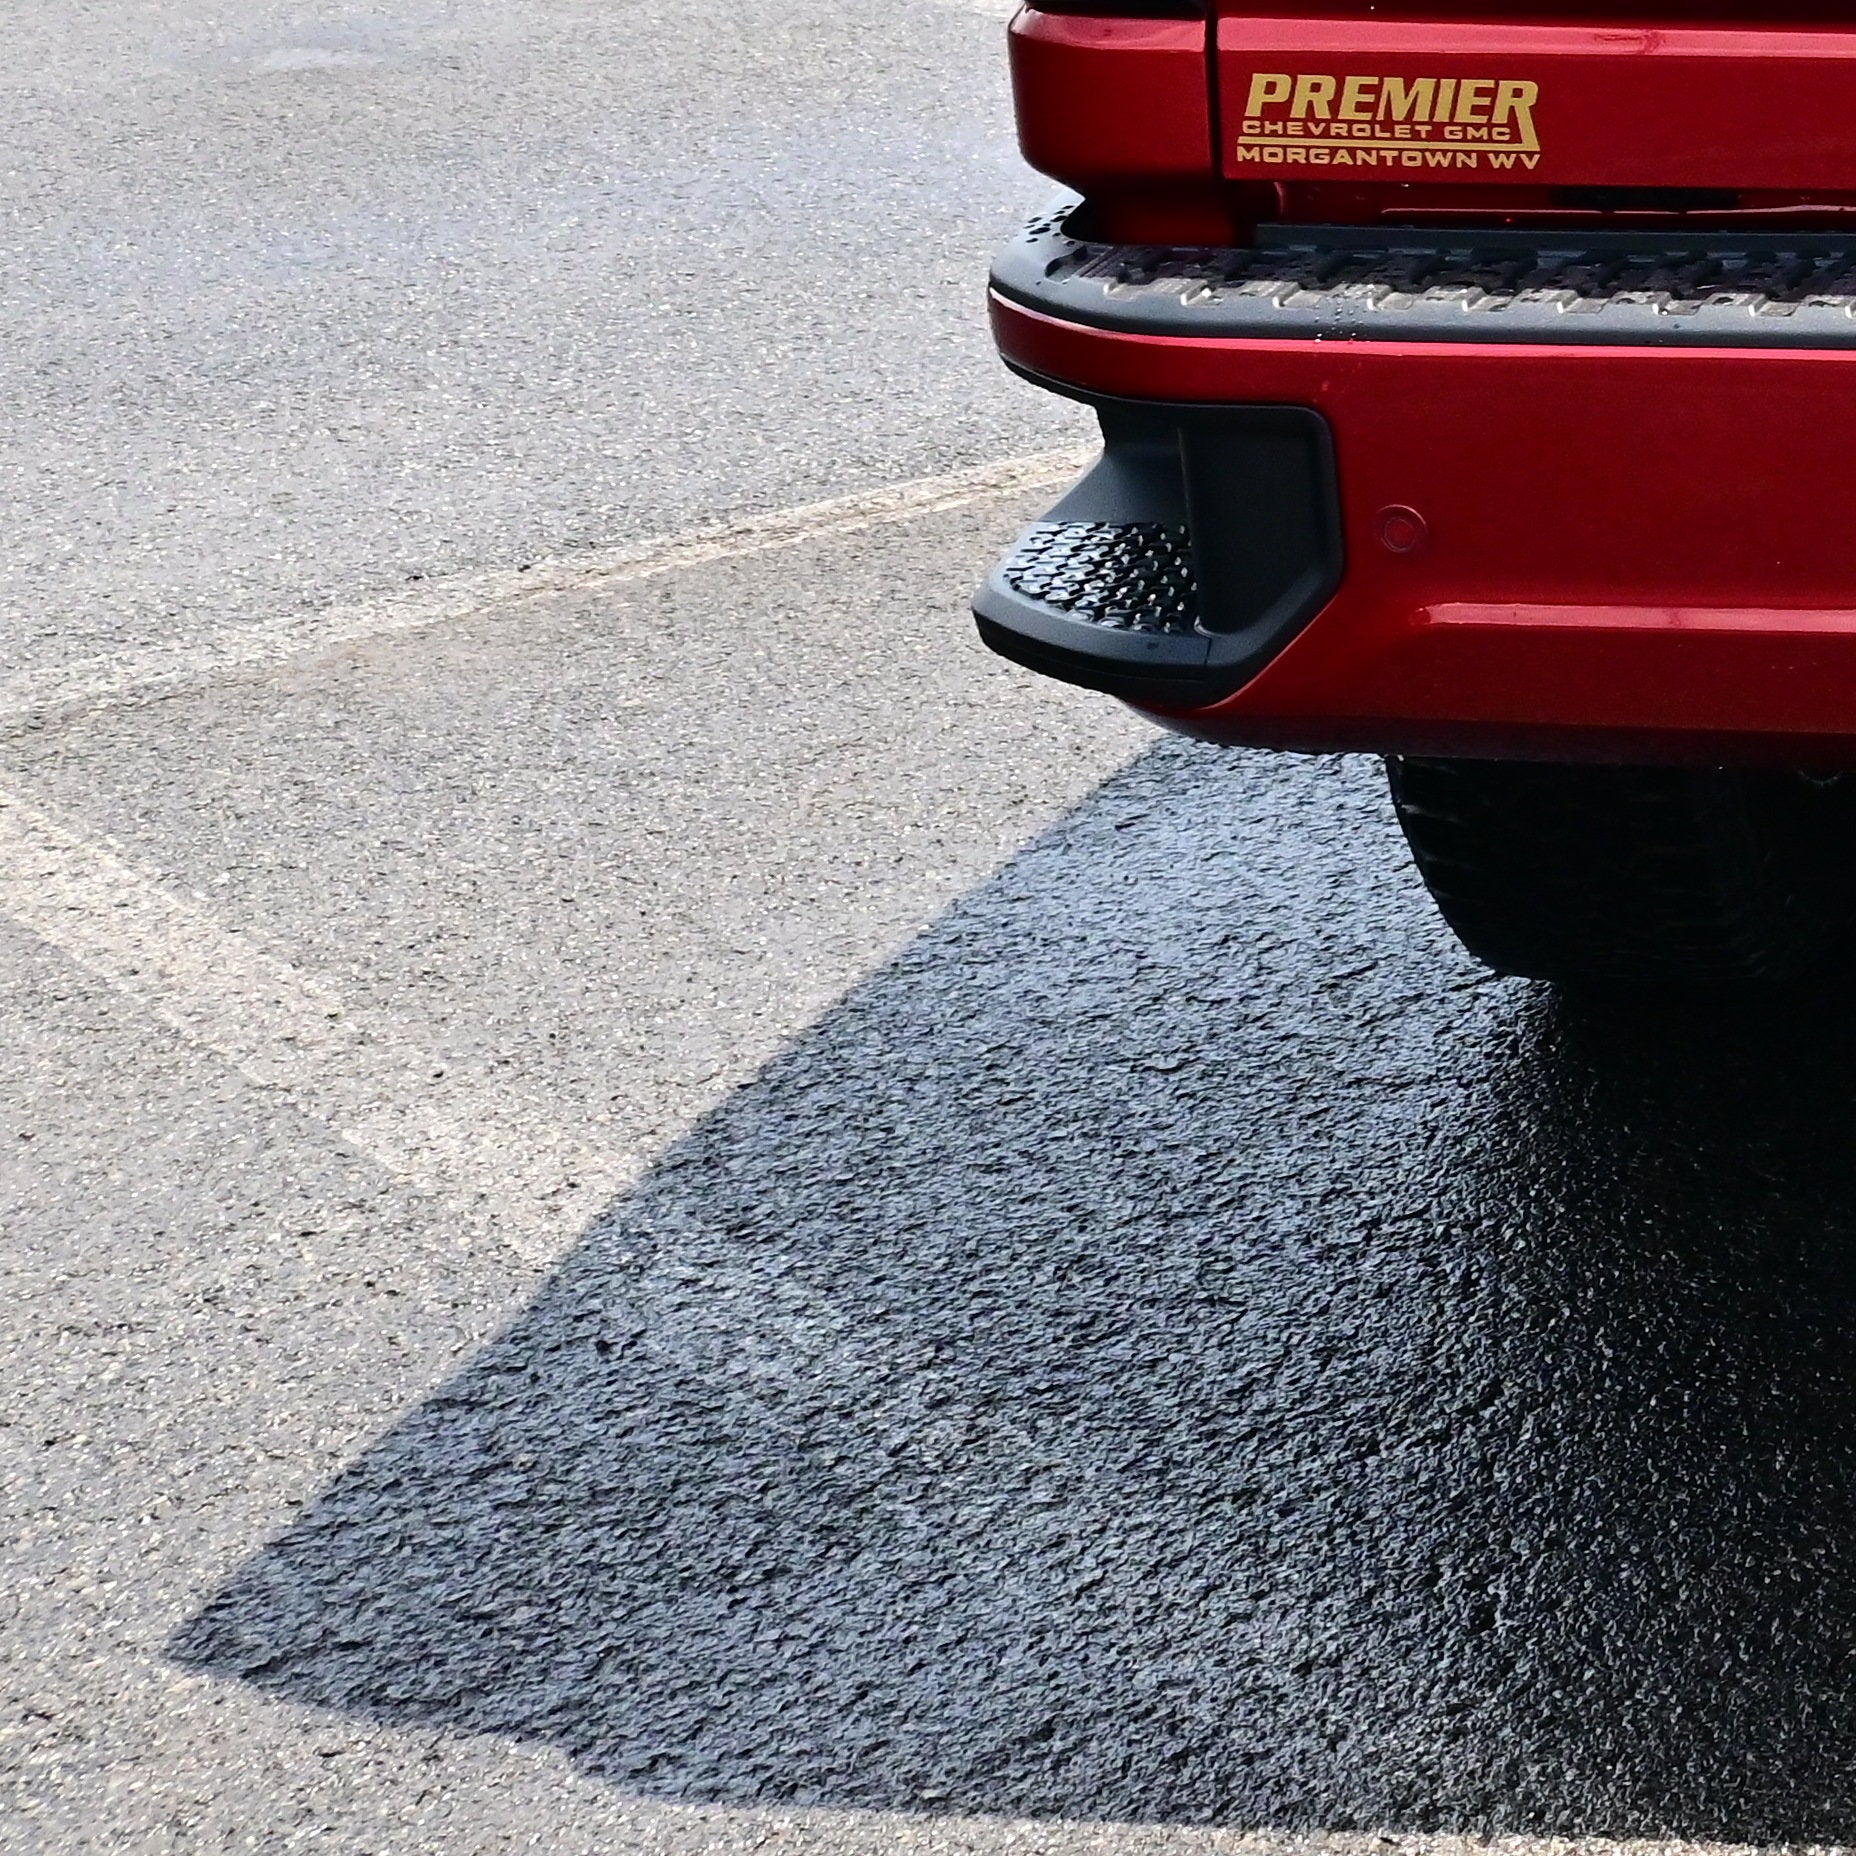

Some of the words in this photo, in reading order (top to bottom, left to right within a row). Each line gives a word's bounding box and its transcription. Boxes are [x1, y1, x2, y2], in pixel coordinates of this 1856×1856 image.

[1244, 73, 1541, 151] PREMIER
[1242, 120, 1433, 139] CHEVROLET
[1443, 126, 1511, 141] GMC
[1236, 146, 1478, 169] MORGANTOWN
[1487, 153, 1541, 170] WV
